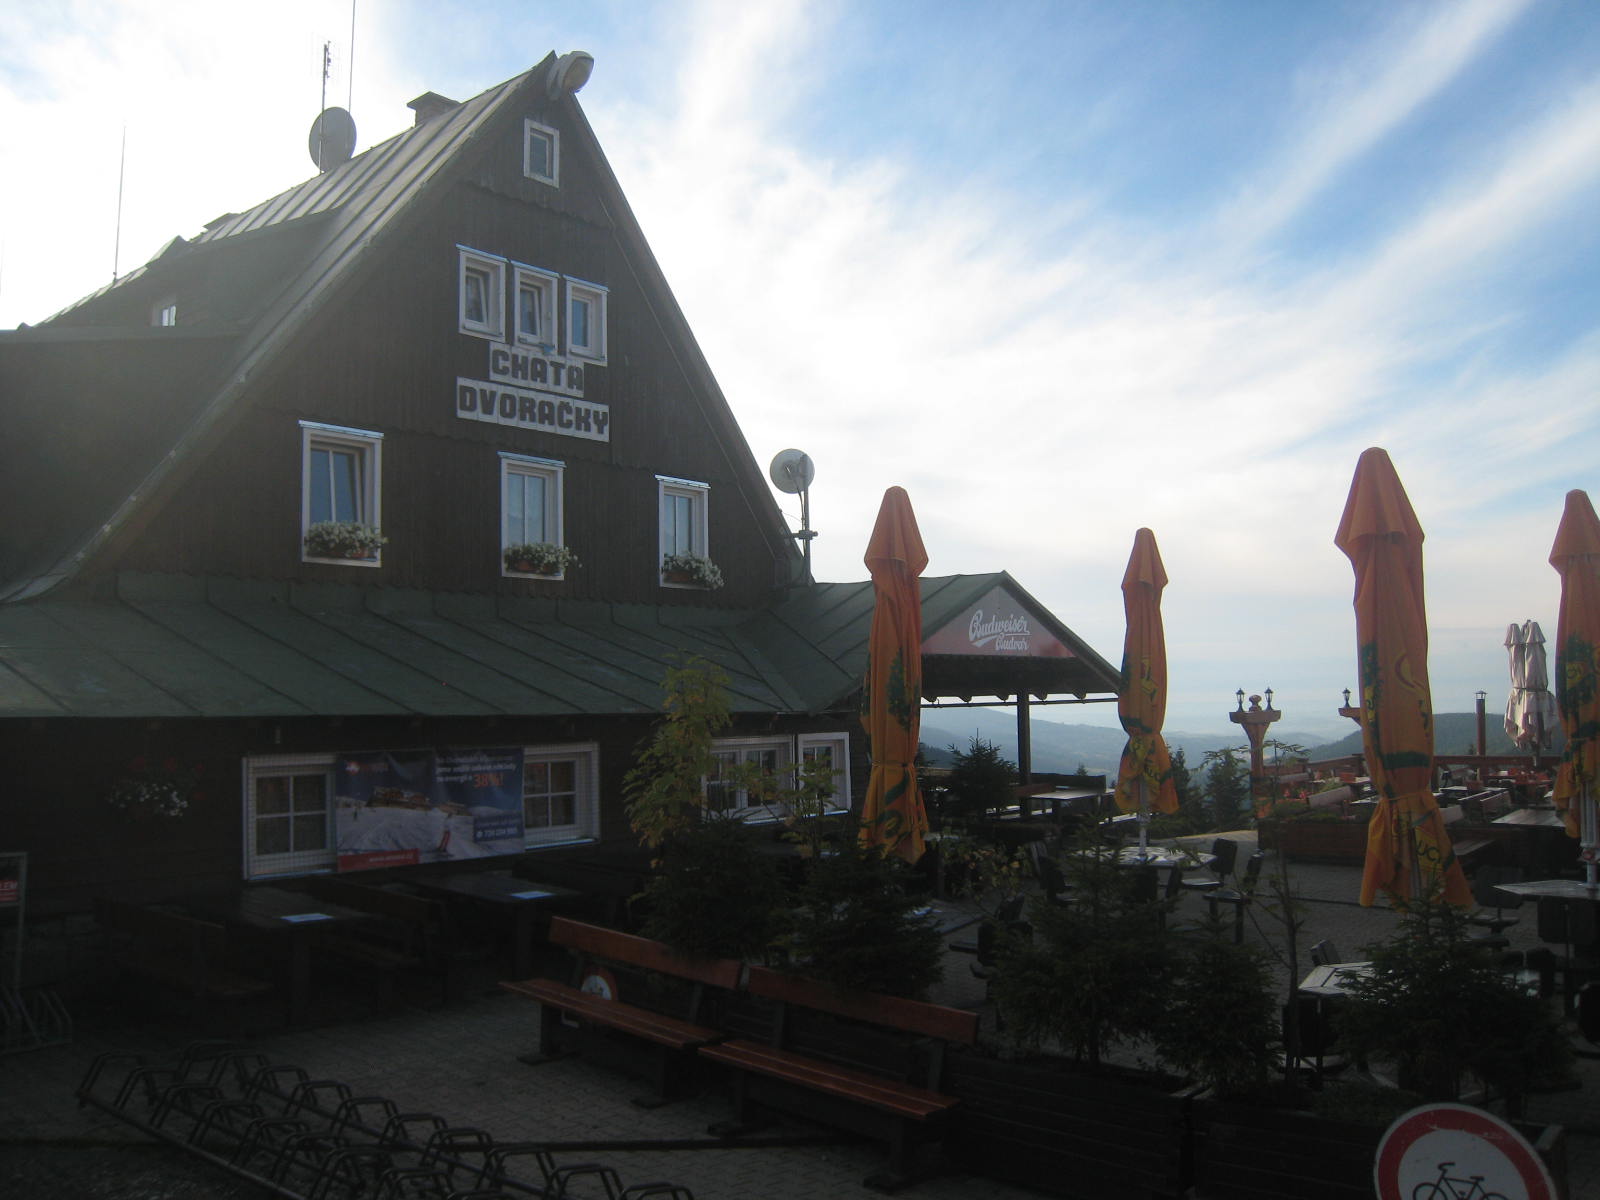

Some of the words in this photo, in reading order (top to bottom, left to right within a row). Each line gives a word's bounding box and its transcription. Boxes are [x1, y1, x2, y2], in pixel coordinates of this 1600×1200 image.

[492, 349, 584, 391] CHATA
[458, 385, 609, 434] DVORAČKY
[969, 609, 1030, 642] Budweiser
[995, 633, 1029, 650] Budvar
